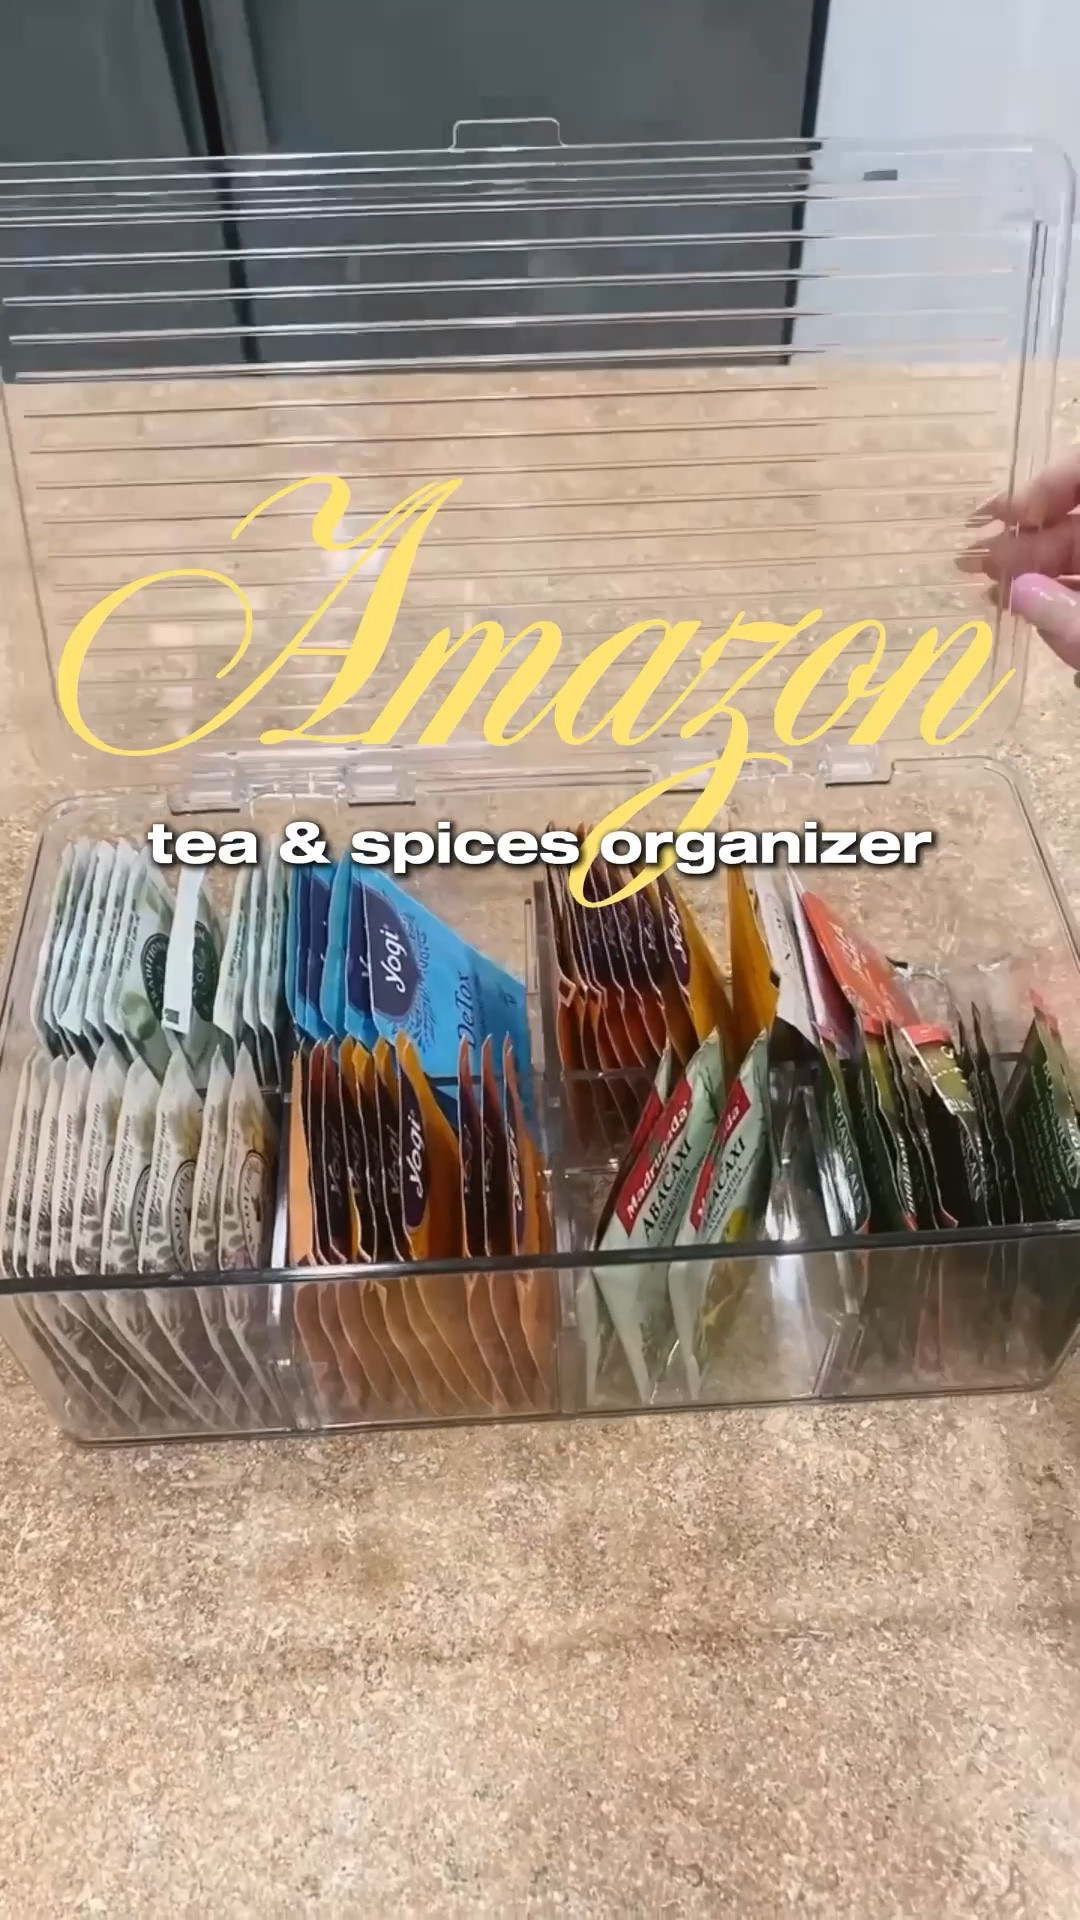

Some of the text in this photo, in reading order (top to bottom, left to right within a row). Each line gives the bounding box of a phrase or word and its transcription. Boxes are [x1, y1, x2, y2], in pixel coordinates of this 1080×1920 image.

[379, 928, 408, 993] Yogi
[457, 970, 477, 1047] DeTox
[406, 1114, 426, 1199] Yogi
[642, 1136, 692, 1240] ABACAXI
